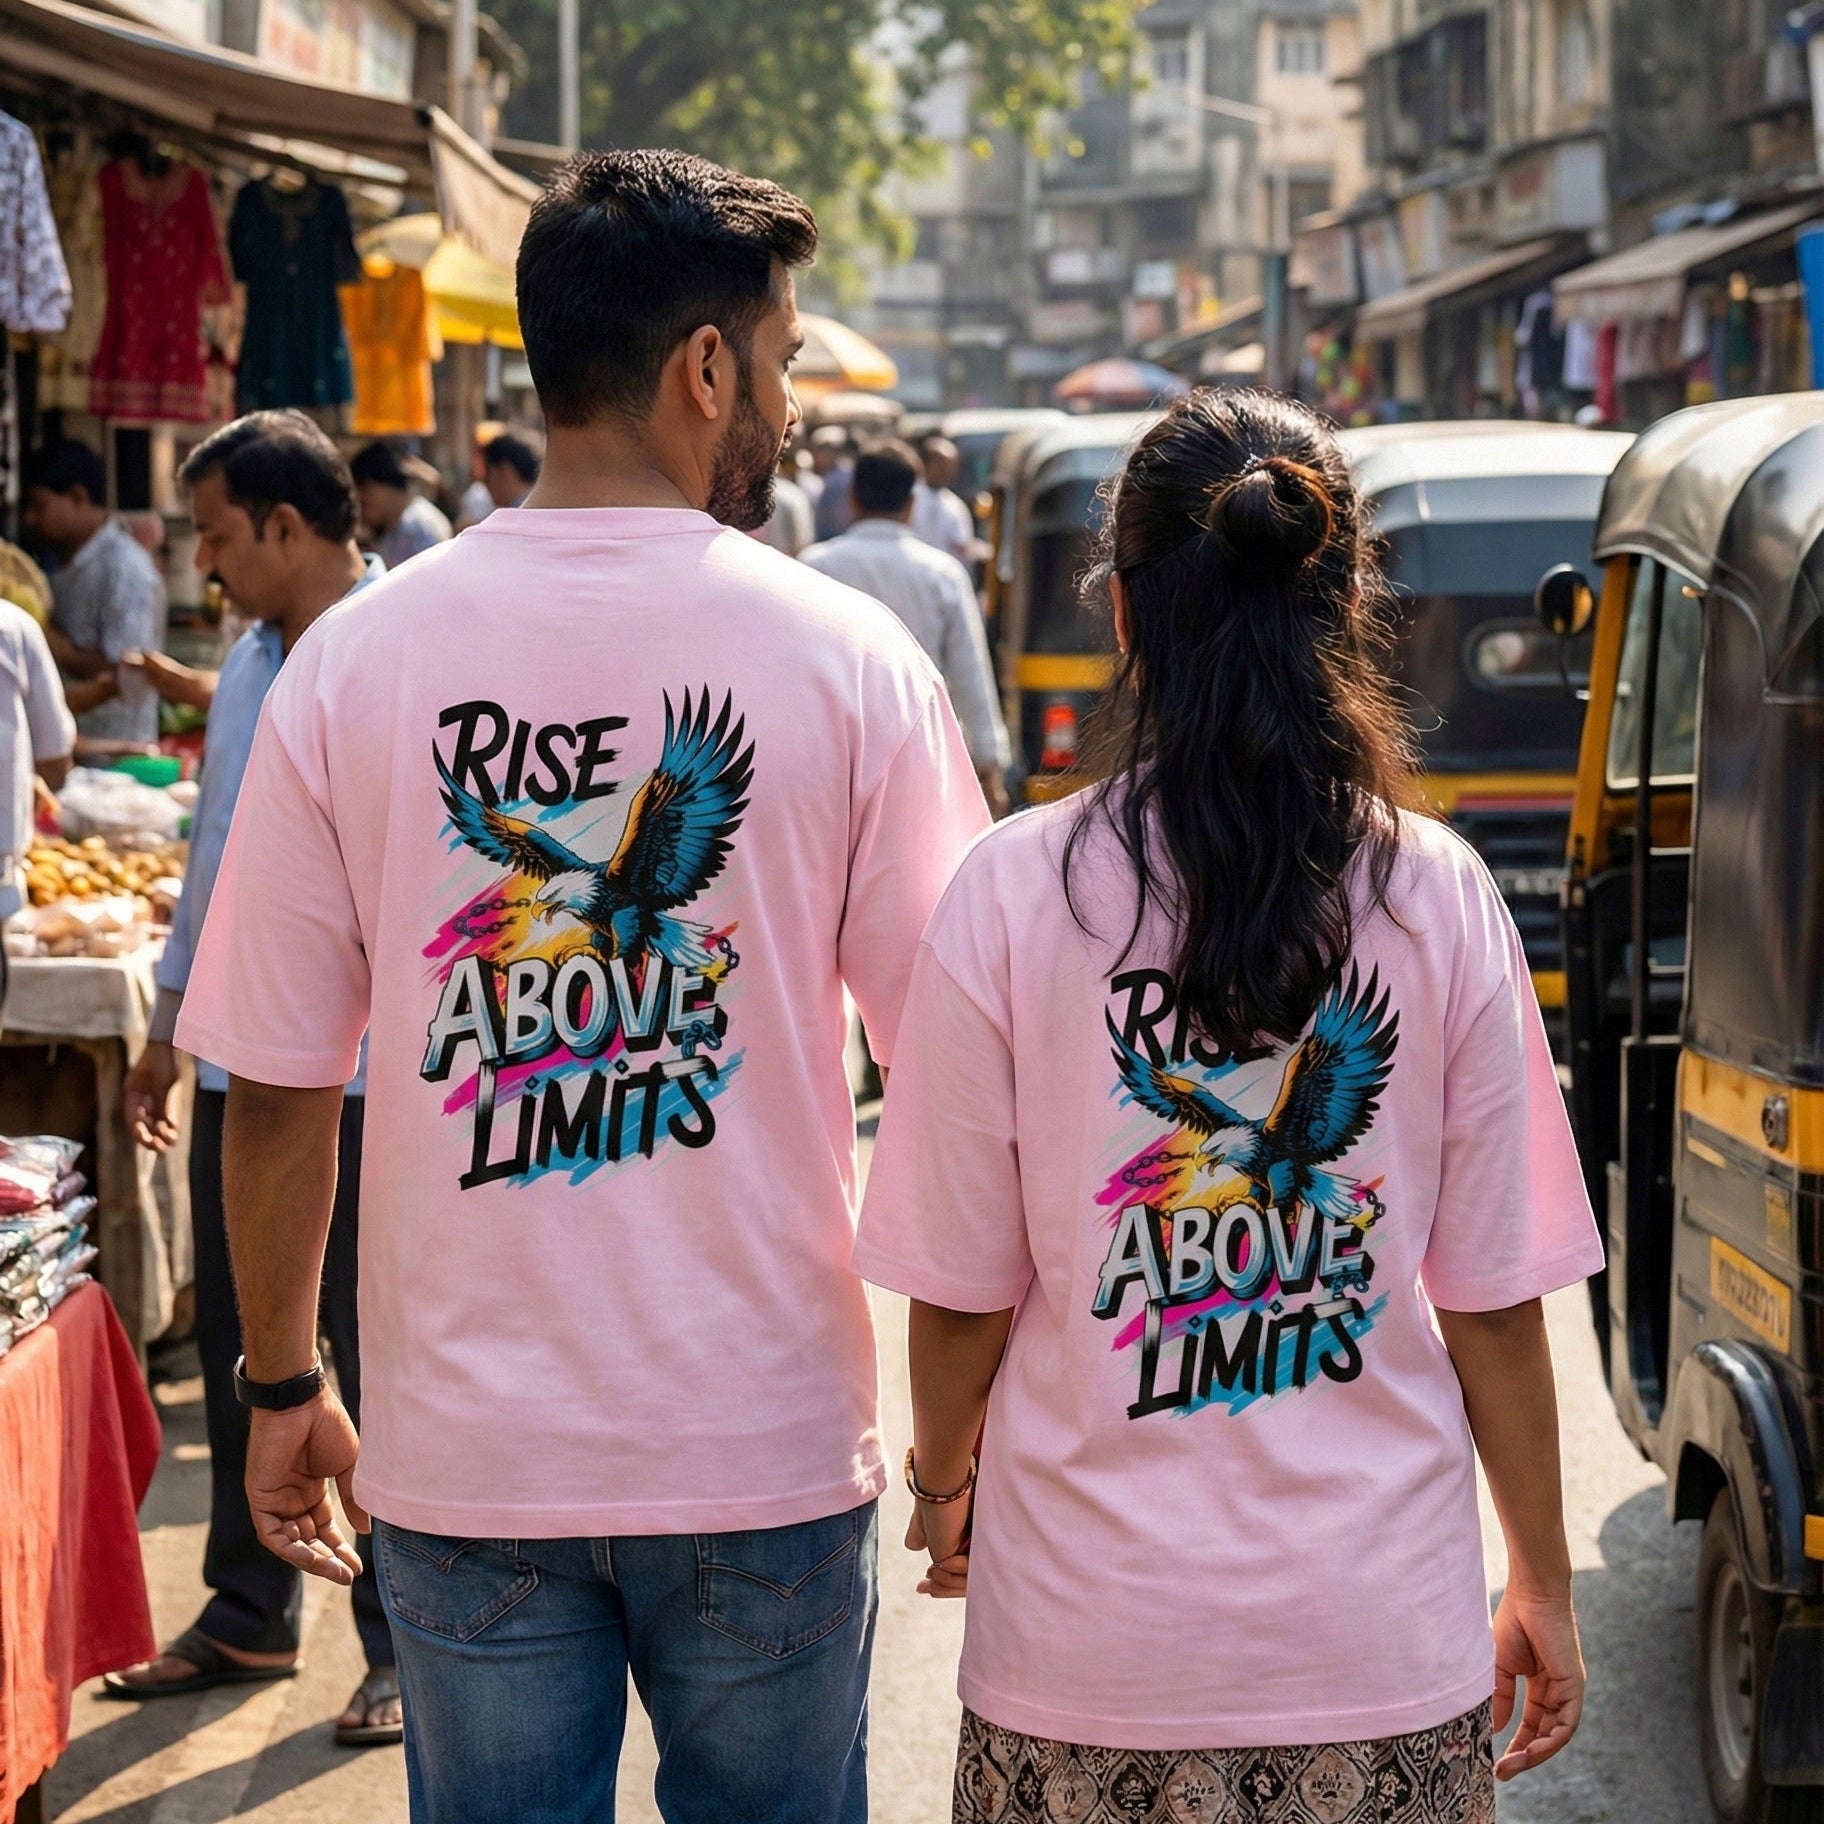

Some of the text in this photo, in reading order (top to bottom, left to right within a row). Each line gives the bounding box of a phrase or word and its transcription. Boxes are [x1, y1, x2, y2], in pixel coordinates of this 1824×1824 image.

[439, 700, 629, 806] RISE
[419, 954, 728, 1083] ABOVE
[1091, 1202, 1375, 1320] ABOVE
